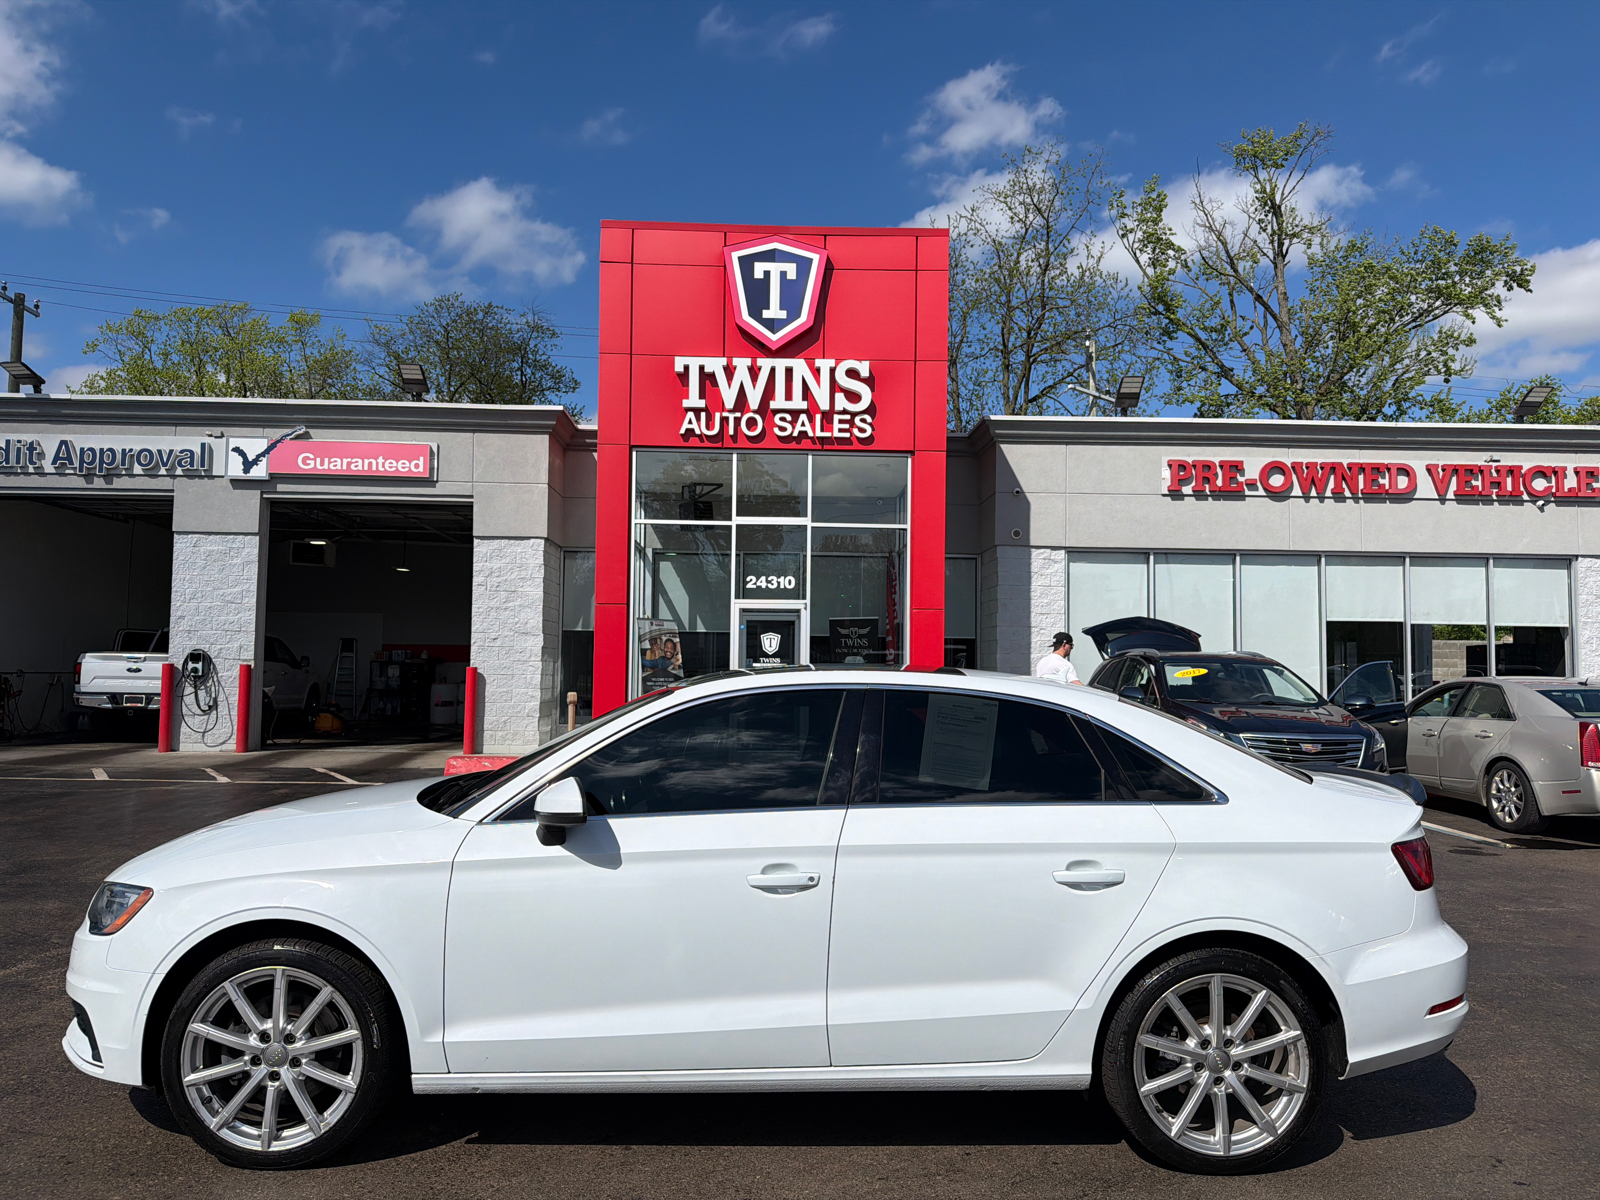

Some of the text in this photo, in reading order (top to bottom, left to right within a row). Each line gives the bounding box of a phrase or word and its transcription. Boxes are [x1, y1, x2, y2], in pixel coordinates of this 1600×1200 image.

[754, 262, 797, 319] T
[674, 356, 873, 413] TWINS
[679, 411, 874, 439] AUTO SALES
[51, 439, 209, 474] Approval
[297, 452, 424, 473] Guaranteed
[1167, 459, 1600, 498] PRE-OWNED VEHICLE
[745, 575, 796, 589] 24310
[765, 637, 776, 648] T
[1180, 669, 1201, 677] 2017
